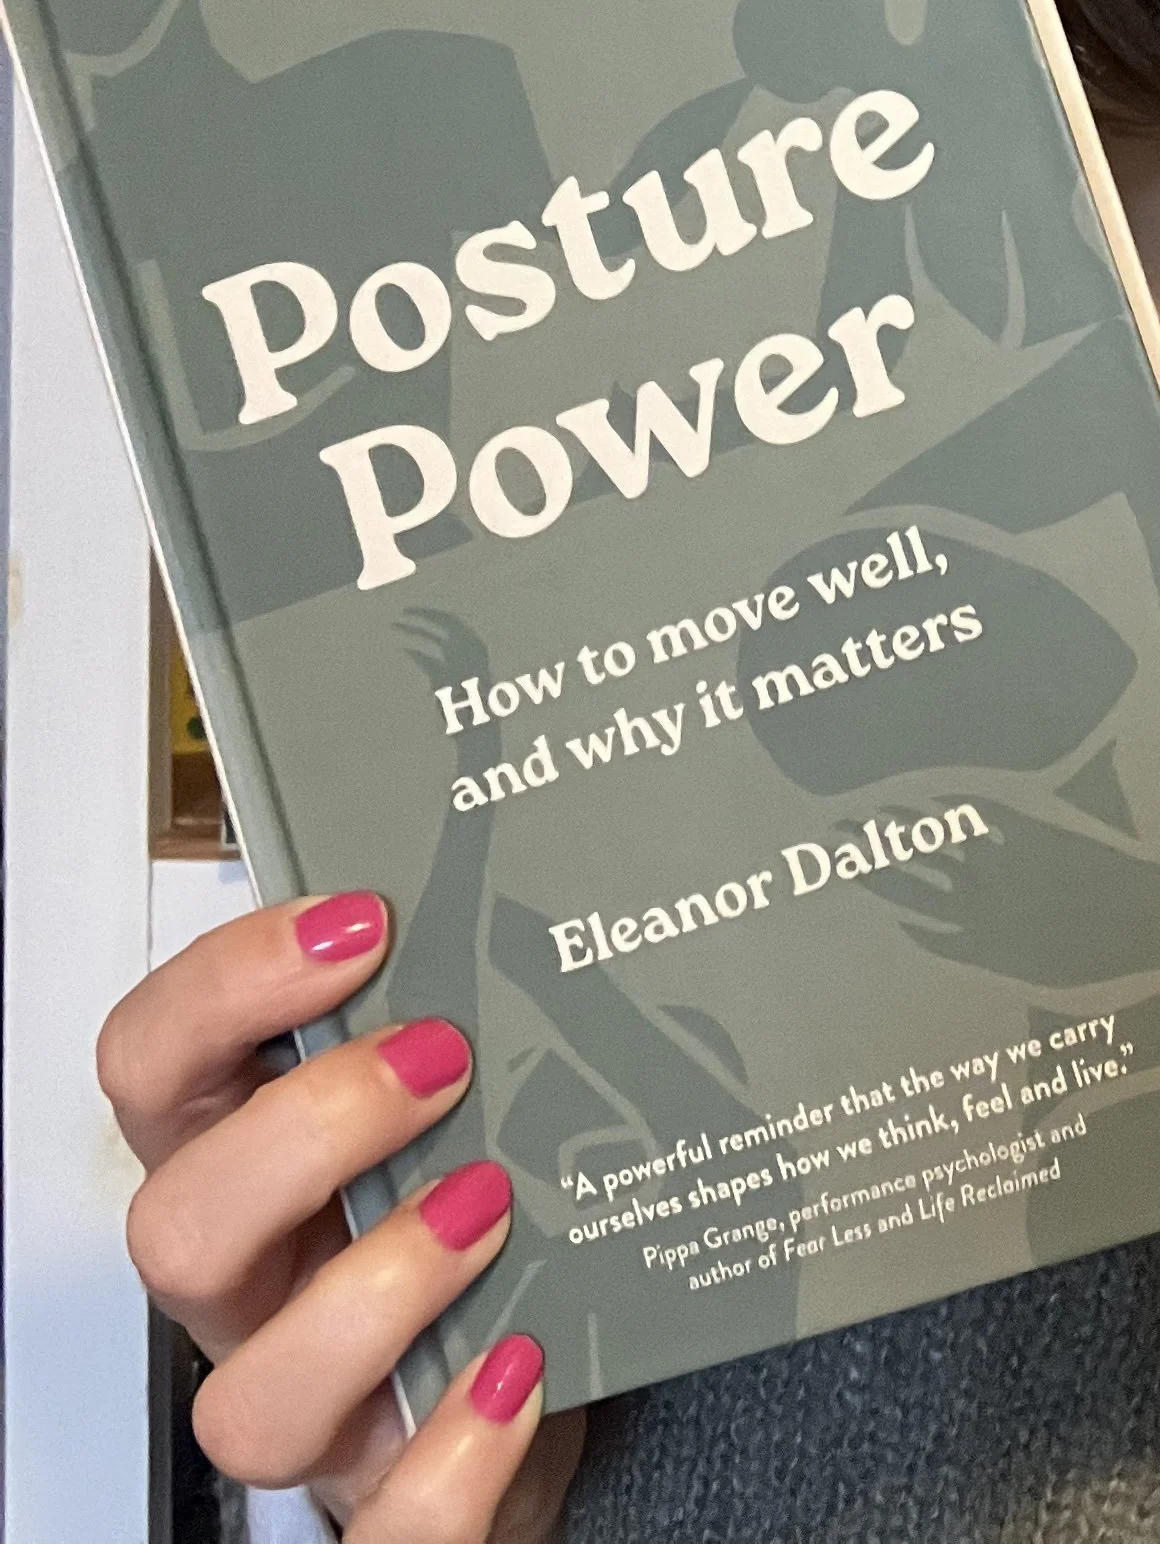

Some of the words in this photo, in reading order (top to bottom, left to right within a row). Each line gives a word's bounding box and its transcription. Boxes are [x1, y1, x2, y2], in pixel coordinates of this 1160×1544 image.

[202, 90, 934, 424] Posture
[320, 295, 914, 590] Power
[435, 661, 565, 735] How
[576, 641, 635, 685] to
[646, 586, 799, 664] move
[807, 524, 947, 604] well,
[451, 735, 559, 811] and
[566, 702, 685, 769] why
[696, 680, 743, 728] it
[752, 604, 982, 710] matters
[549, 870, 772, 972] Eleanor
[781, 804, 989, 896] Dalton
[560, 1171, 597, 1201] “A
[603, 1133, 712, 1204] powerful
[719, 1102, 833, 1154] reminder
[840, 1082, 896, 1116] that
[900, 1067, 944, 1097] the
[950, 1050, 999, 1084] way
[1006, 1040, 1041, 1064] we
[1050, 1014, 1114, 1049] carry
[569, 1197, 682, 1244] ourselves
[688, 1168, 773, 1213] shapes
[776, 1149, 829, 1180] how
[836, 1138, 872, 1162] we
[878, 1104, 959, 1149] think,
[962, 1082, 1013, 1122] feel
[1021, 1064, 1067, 1105] and
[1072, 1042, 1133, 1093] live.”
[642, 1241, 700, 1271] Pippa
[703, 1218, 784, 1249] Grange,
[788, 1175, 917, 1229] performance
[922, 1130, 1045, 1190] psychologist
[1050, 1112, 1086, 1143] and
[689, 1259, 752, 1290] author
[758, 1243, 776, 1269] of
[784, 1236, 825, 1262] Fear
[832, 1224, 871, 1246] Less
[878, 1203, 913, 1233] and
[918, 1192, 954, 1223] Life
[960, 1159, 1062, 1206] Reclaimed
